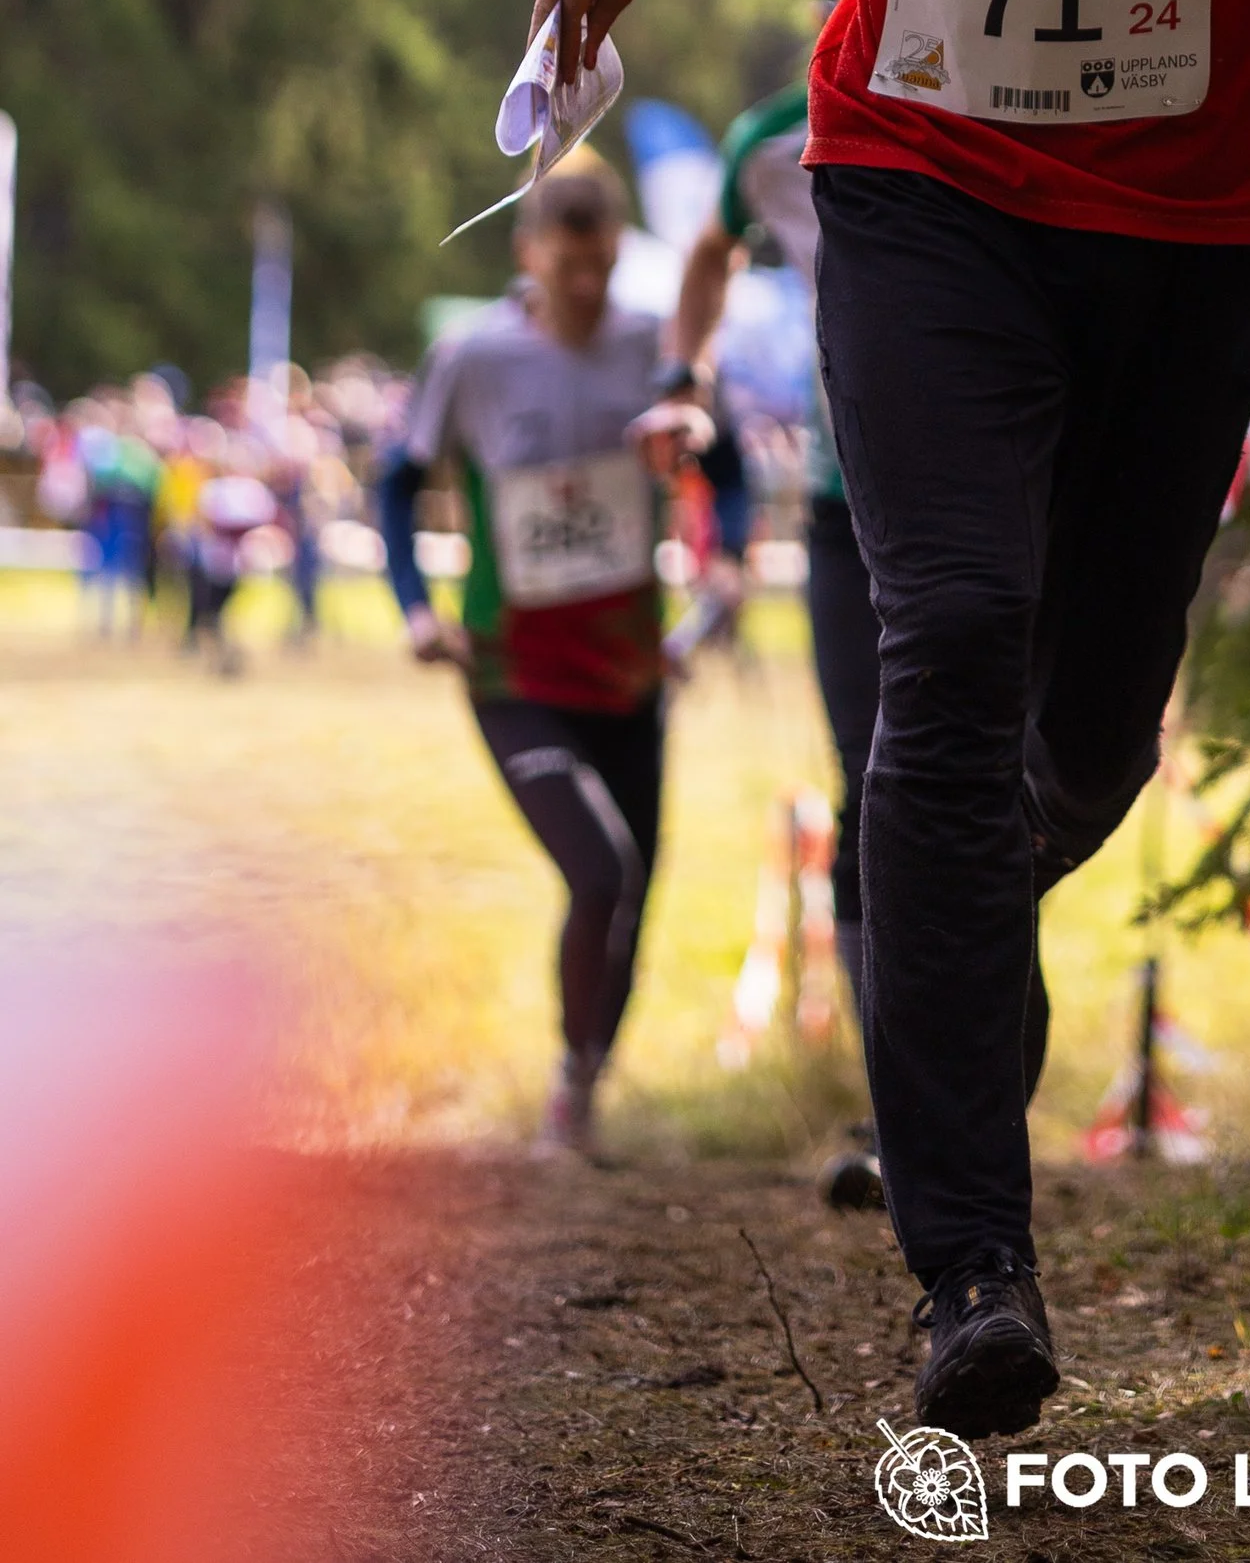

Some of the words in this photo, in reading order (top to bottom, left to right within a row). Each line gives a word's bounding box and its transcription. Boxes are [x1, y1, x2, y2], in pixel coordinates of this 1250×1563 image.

[904, 33, 942, 68] 25
[1120, 53, 1198, 74] UPPLANDS
[1120, 73, 1168, 91] VÄSBY
